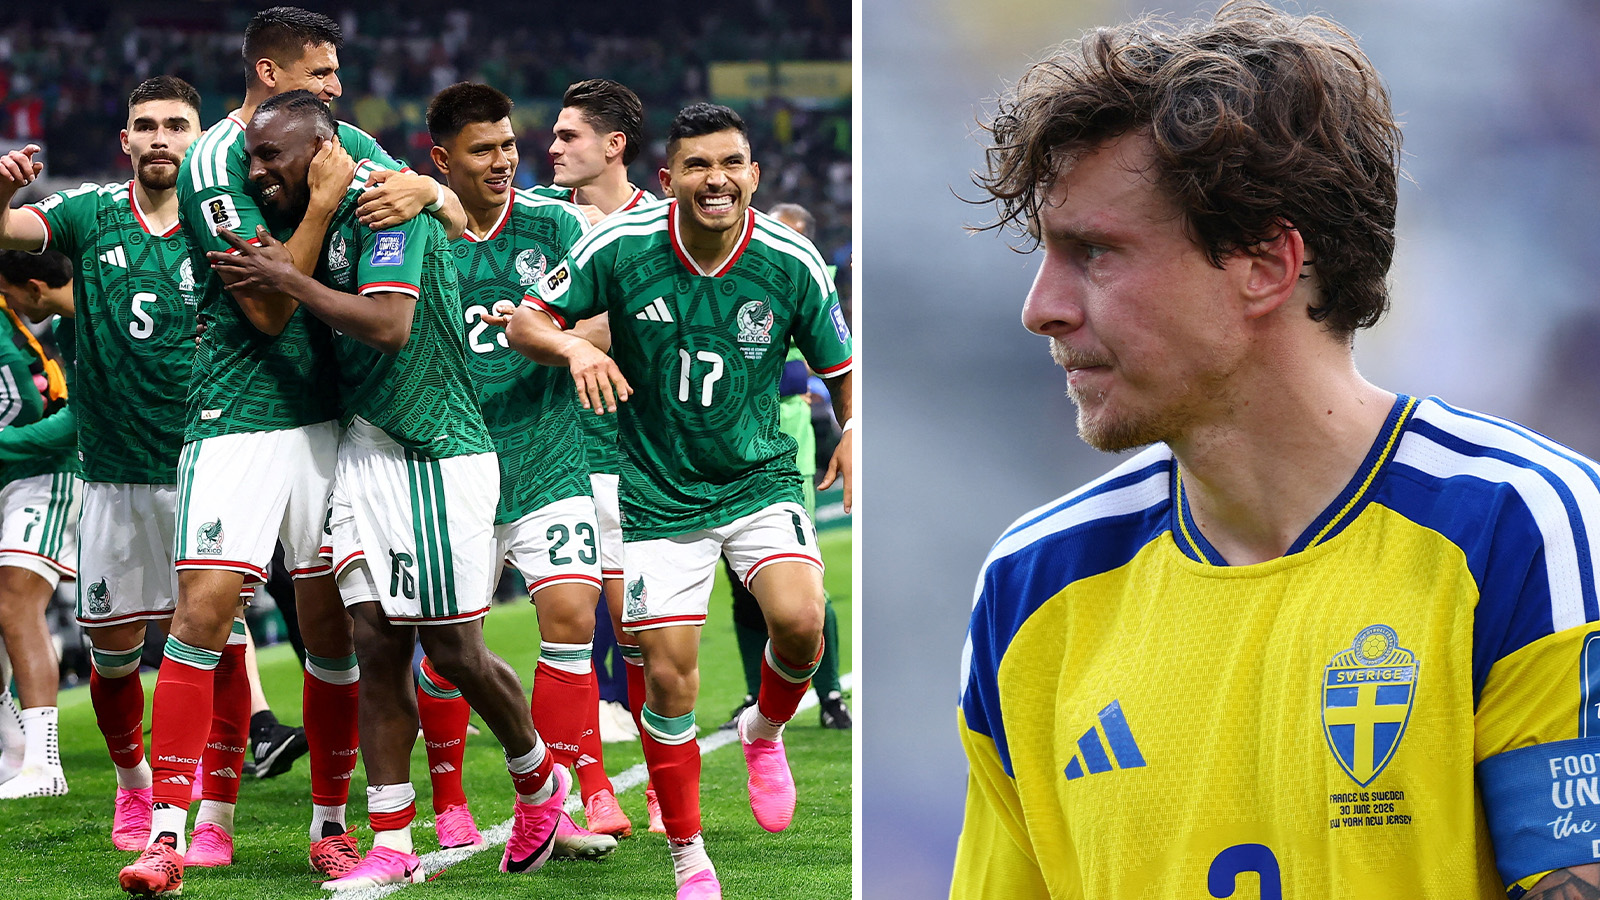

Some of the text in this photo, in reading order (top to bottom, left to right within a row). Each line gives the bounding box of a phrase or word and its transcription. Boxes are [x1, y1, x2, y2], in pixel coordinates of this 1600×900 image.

[129, 292, 157, 339] 5
[678, 348, 724, 407] 17
[23, 507, 41, 542] 7
[546, 522, 597, 566] 23
[389, 548, 415, 600] 16
[1336, 669, 1403, 682] SVERIGE
[158, 754, 199, 765] MÉXICO
[1330, 790, 1405, 804] FRANCE VS SWEDEN
[1340, 803, 1395, 815] 30 JUNE 2026
[1342, 816, 1364, 828] YORK
[1365, 815, 1384, 827] NEW
[1386, 814, 1412, 826] JERSEY
[1547, 811, 1597, 840] the
